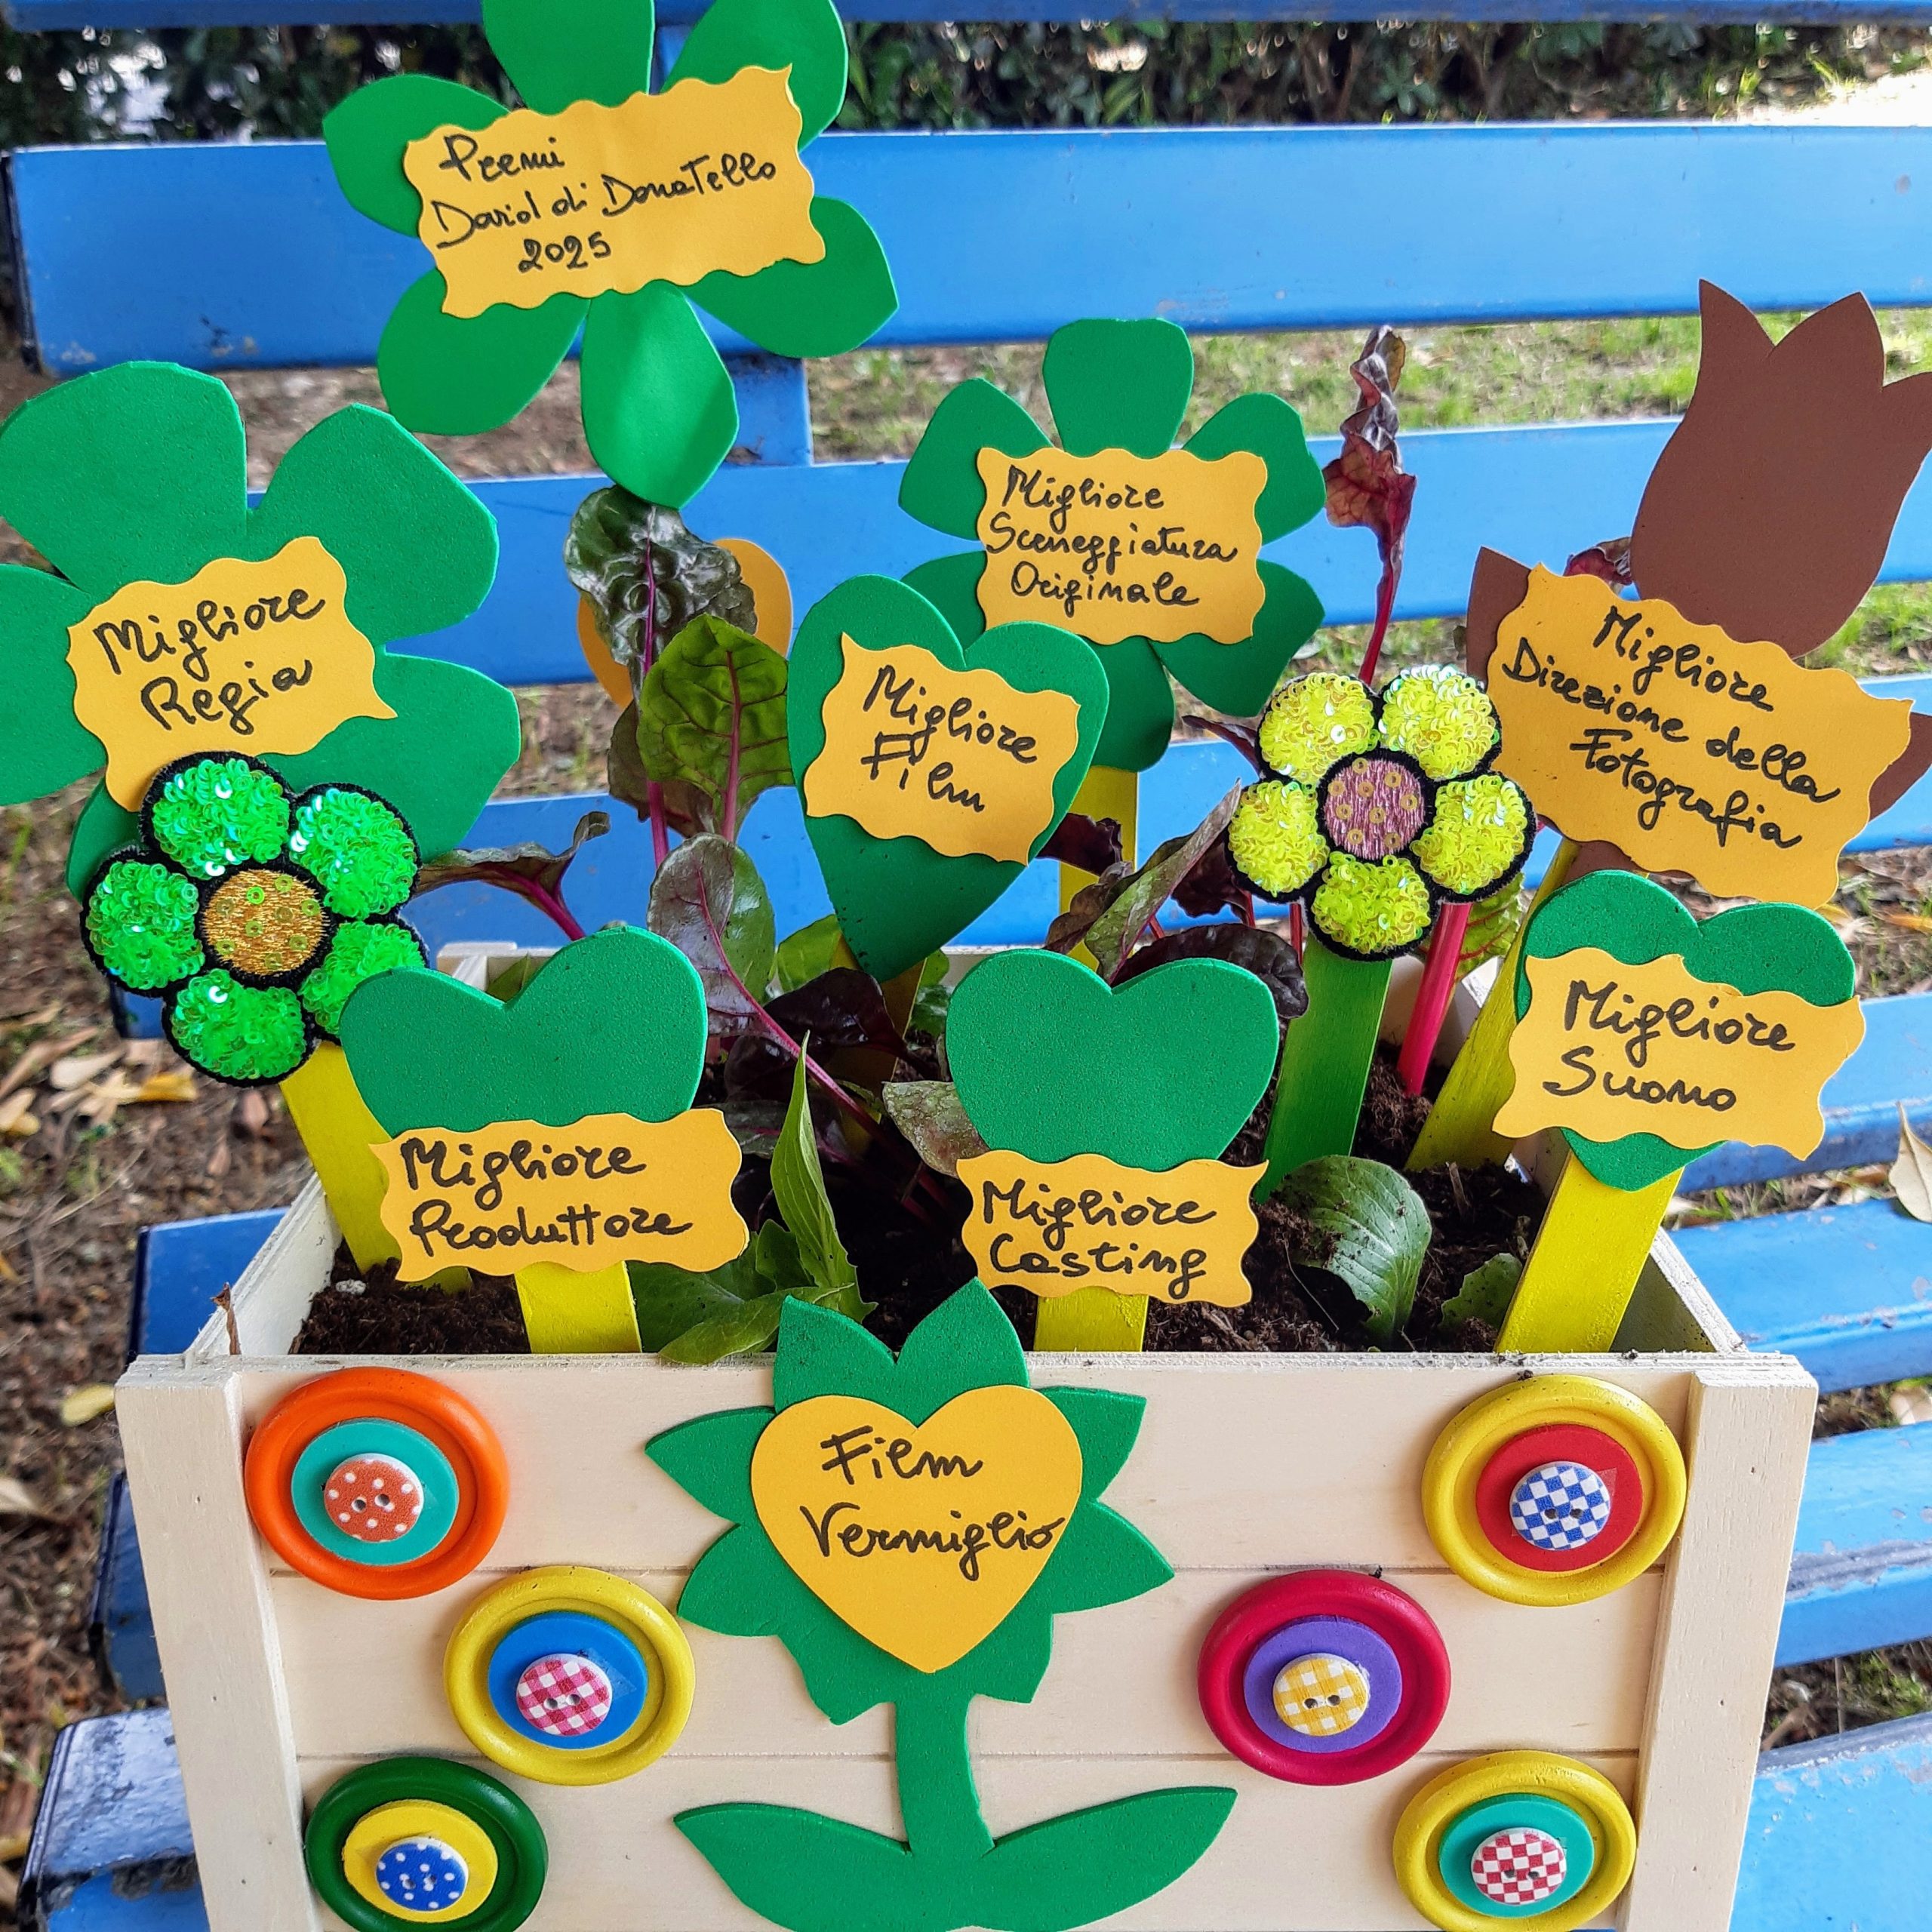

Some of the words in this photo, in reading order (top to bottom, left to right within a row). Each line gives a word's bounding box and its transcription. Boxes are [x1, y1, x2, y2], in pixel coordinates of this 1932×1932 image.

[439, 134, 565, 182] Premi
[552, 183, 587, 214] di
[518, 231, 611, 273] 2025
[1001, 464, 1164, 534] Migliore
[986, 511, 1238, 574] Sceneggiatura
[1011, 561, 1199, 618] Originale
[93, 589, 325, 682] Migliore
[1592, 605, 1774, 712] Migliore
[141, 660, 312, 735] Regia
[863, 664, 1038, 764] Migliore
[1503, 637, 1688, 743] Direzione
[1706, 726, 1841, 804] della
[860, 731, 986, 813] Film
[1570, 728, 1802, 848] Fotografia
[1564, 980, 1795, 1069] Migliore
[1543, 1045, 1737, 1112] Suono
[401, 1137, 647, 1211] Migliore
[409, 1198, 694, 1257] Produttore
[983, 1178, 1217, 1251] Migliore
[989, 1232, 1207, 1300] Casting
[820, 1425, 983, 1485] Film
[799, 1502, 1066, 1581] Vermiglio
